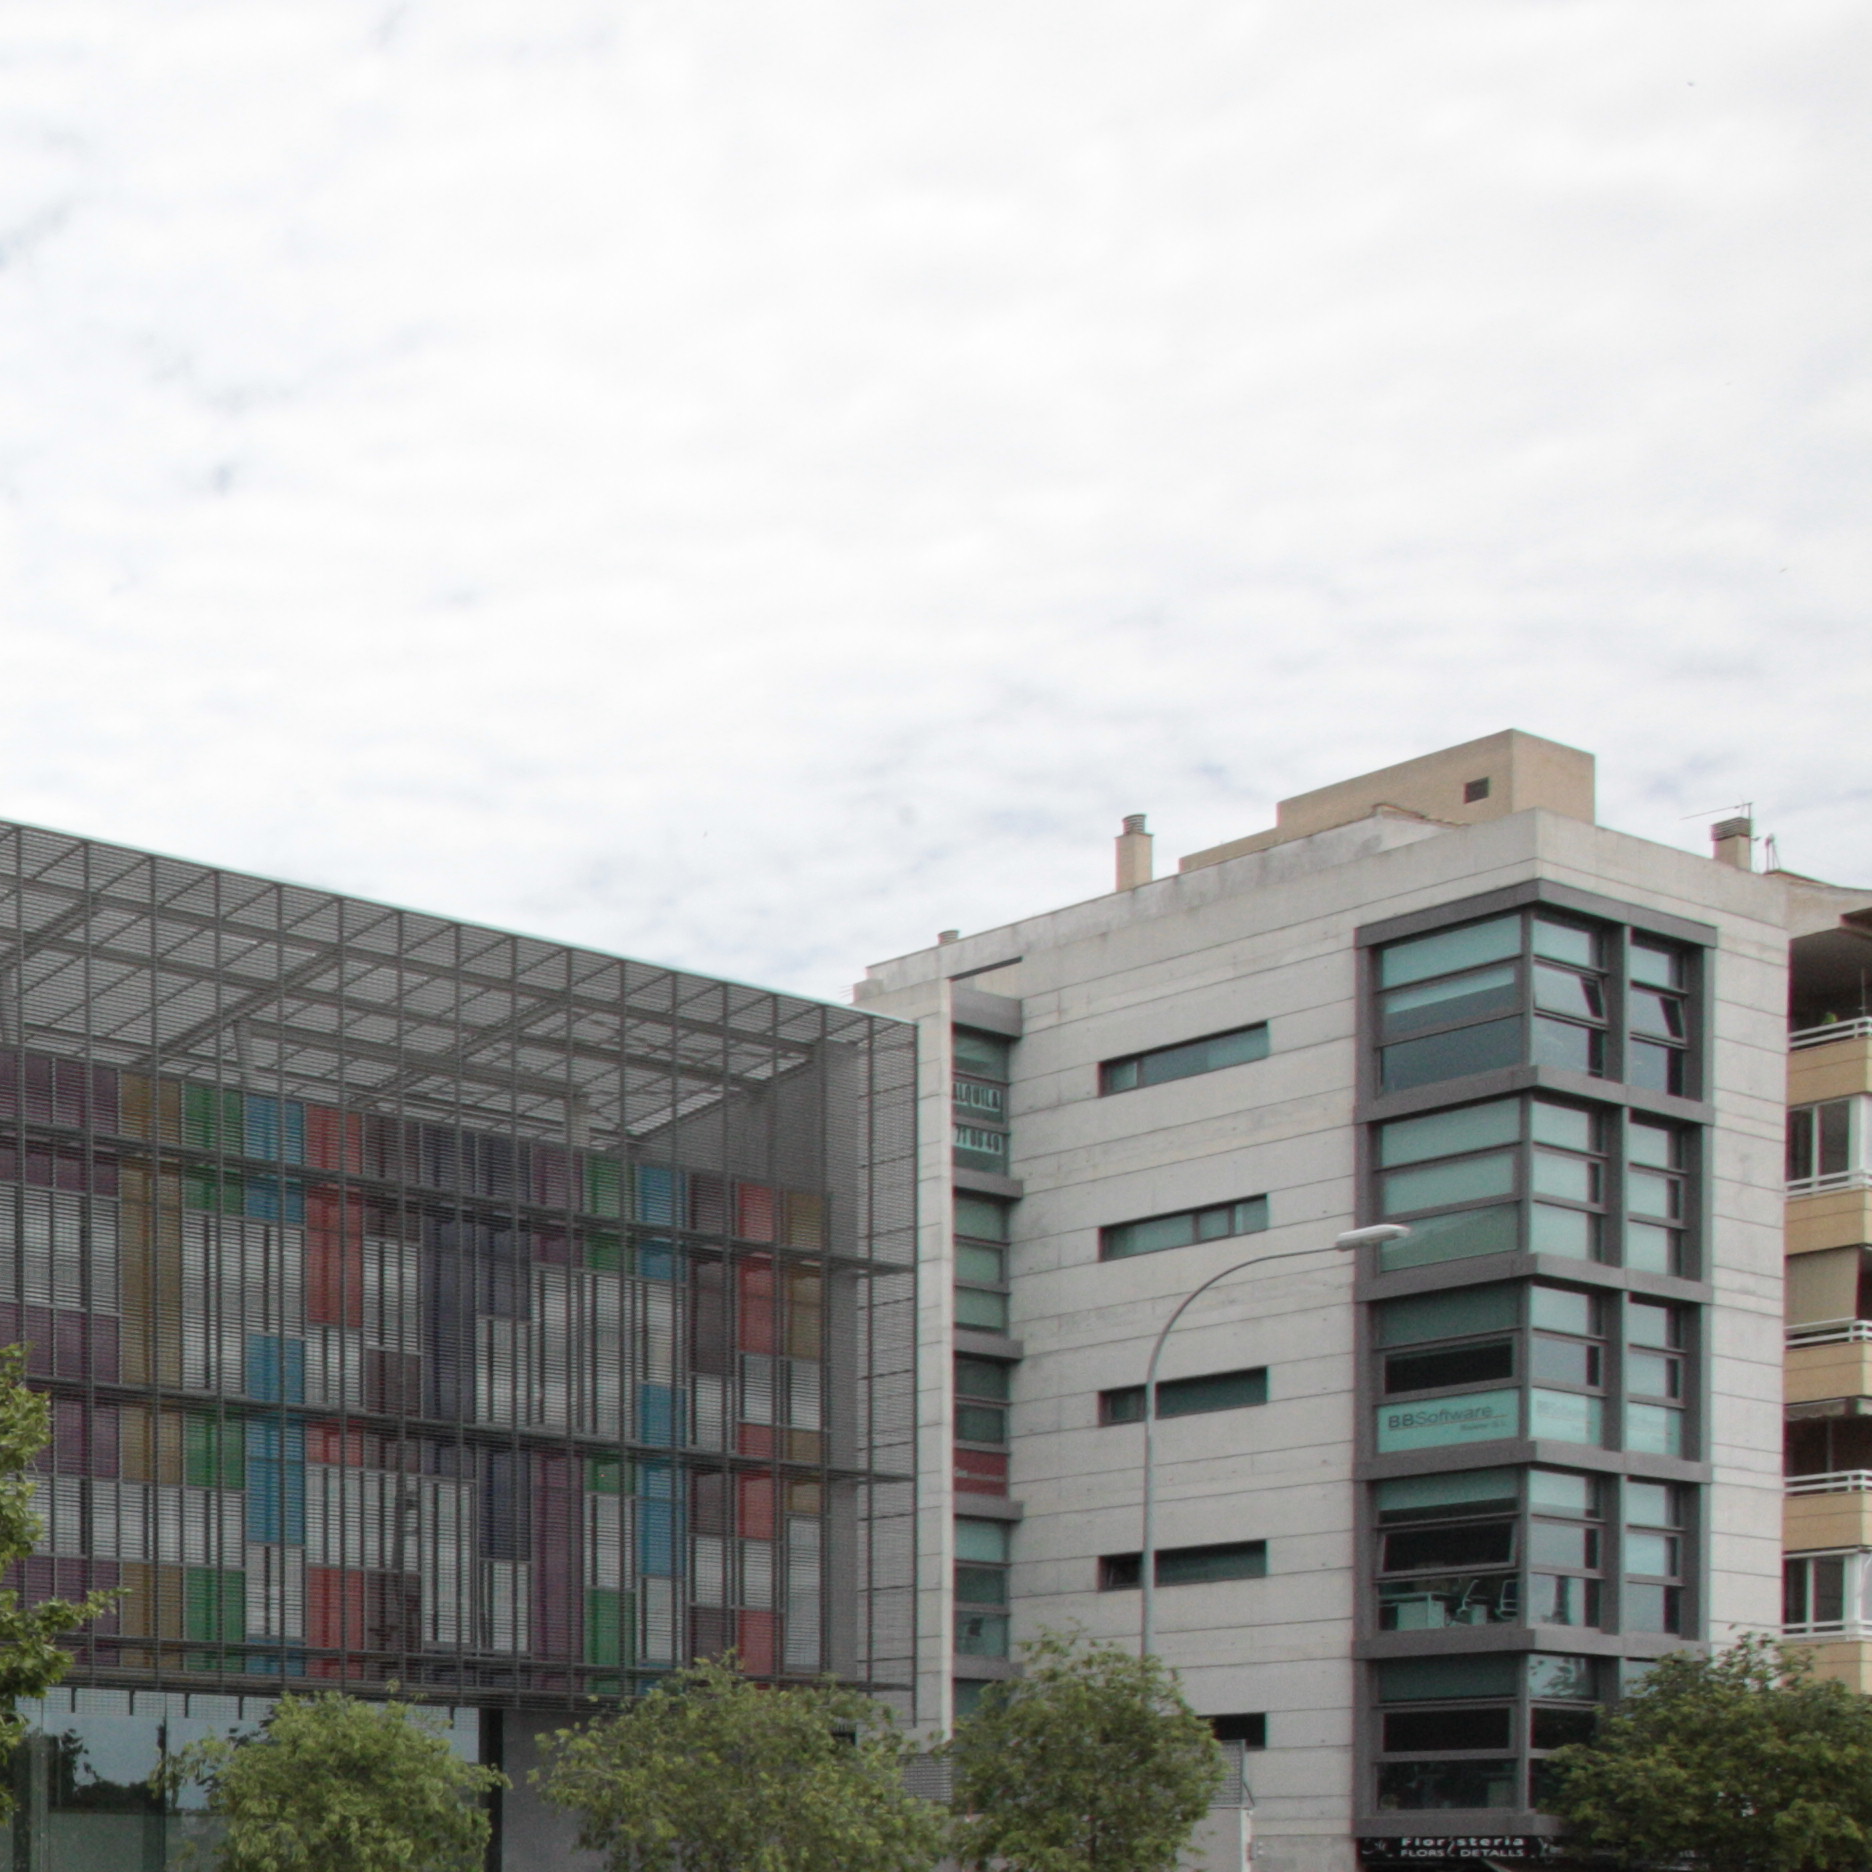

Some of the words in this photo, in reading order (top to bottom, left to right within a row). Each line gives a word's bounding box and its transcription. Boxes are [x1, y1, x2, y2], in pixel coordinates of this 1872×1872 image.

[1388, 1406, 1492, 1429] BBSoftware
[1400, 1849, 1445, 1857] FLORS
[1460, 1849, 1524, 1857] DETALLS
